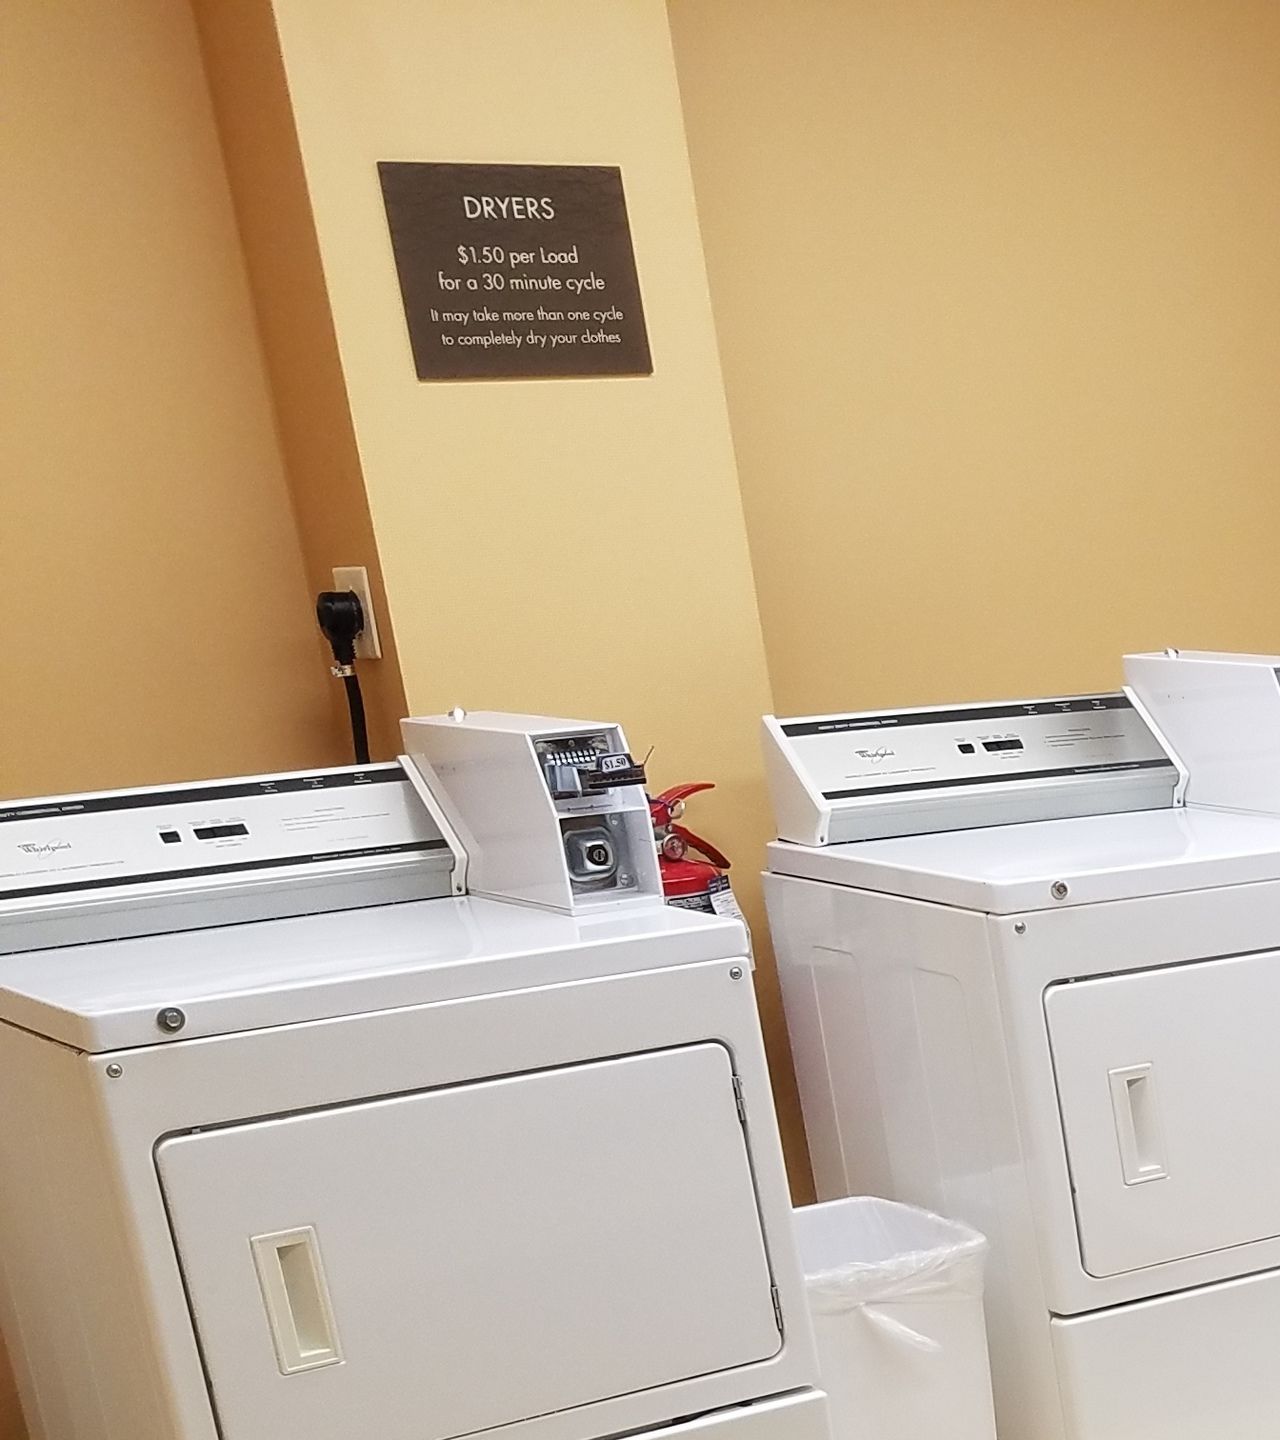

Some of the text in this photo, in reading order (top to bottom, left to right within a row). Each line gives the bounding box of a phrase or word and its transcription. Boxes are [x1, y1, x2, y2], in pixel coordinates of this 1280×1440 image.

[463, 196, 555, 220] DRYERS
[457, 246, 578, 268] $1.50 per Load
[438, 271, 606, 294] for a 30 minute cycle
[430, 306, 624, 325] It may take more than one cycle
[442, 330, 621, 348] to completely dry your clothes
[604, 758, 626, 770] $1.50
[17, 840, 72, 853] Whirlpool
